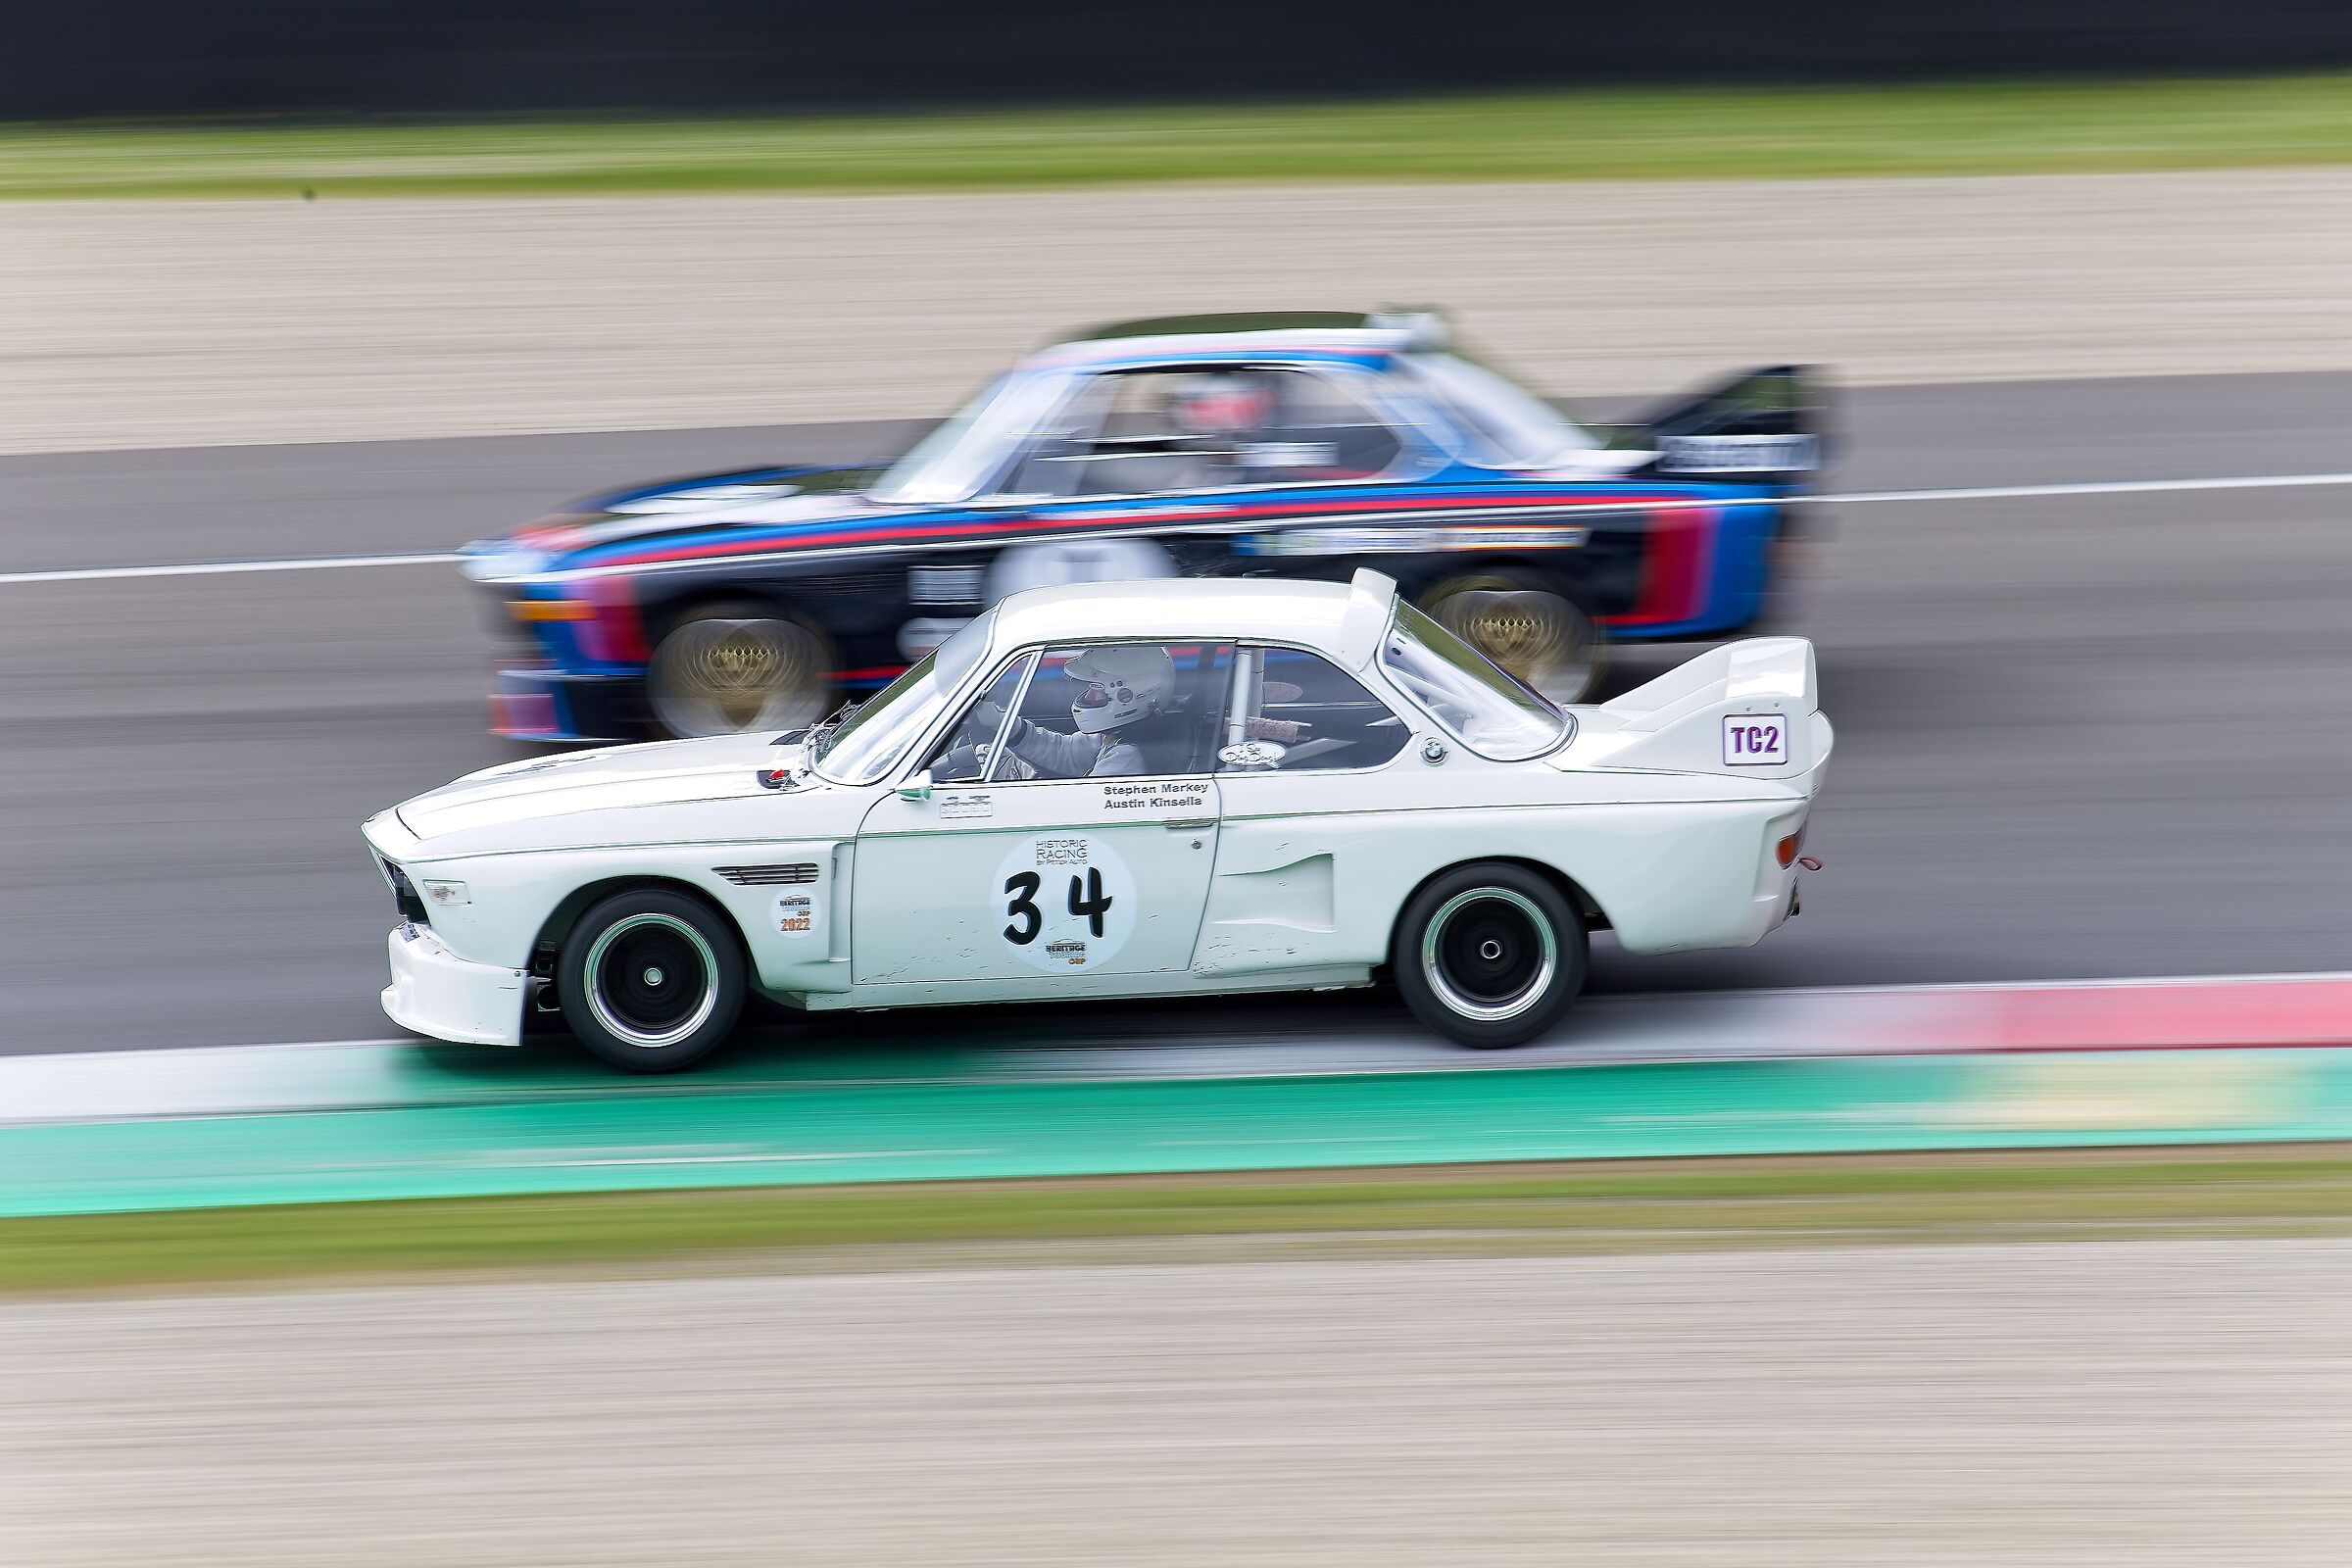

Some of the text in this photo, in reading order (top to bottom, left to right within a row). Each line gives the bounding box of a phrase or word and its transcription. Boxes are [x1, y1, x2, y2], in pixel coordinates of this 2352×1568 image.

[1731, 726, 1779, 754] TC2
[1103, 783, 1208, 796] Stephen Markey
[1103, 796, 1202, 809] Austin Kinsella
[1036, 839, 1088, 849] HISTORIC
[1036, 848, 1088, 859] RACING
[1003, 866, 1113, 946] 34
[780, 918, 810, 931] 2022
